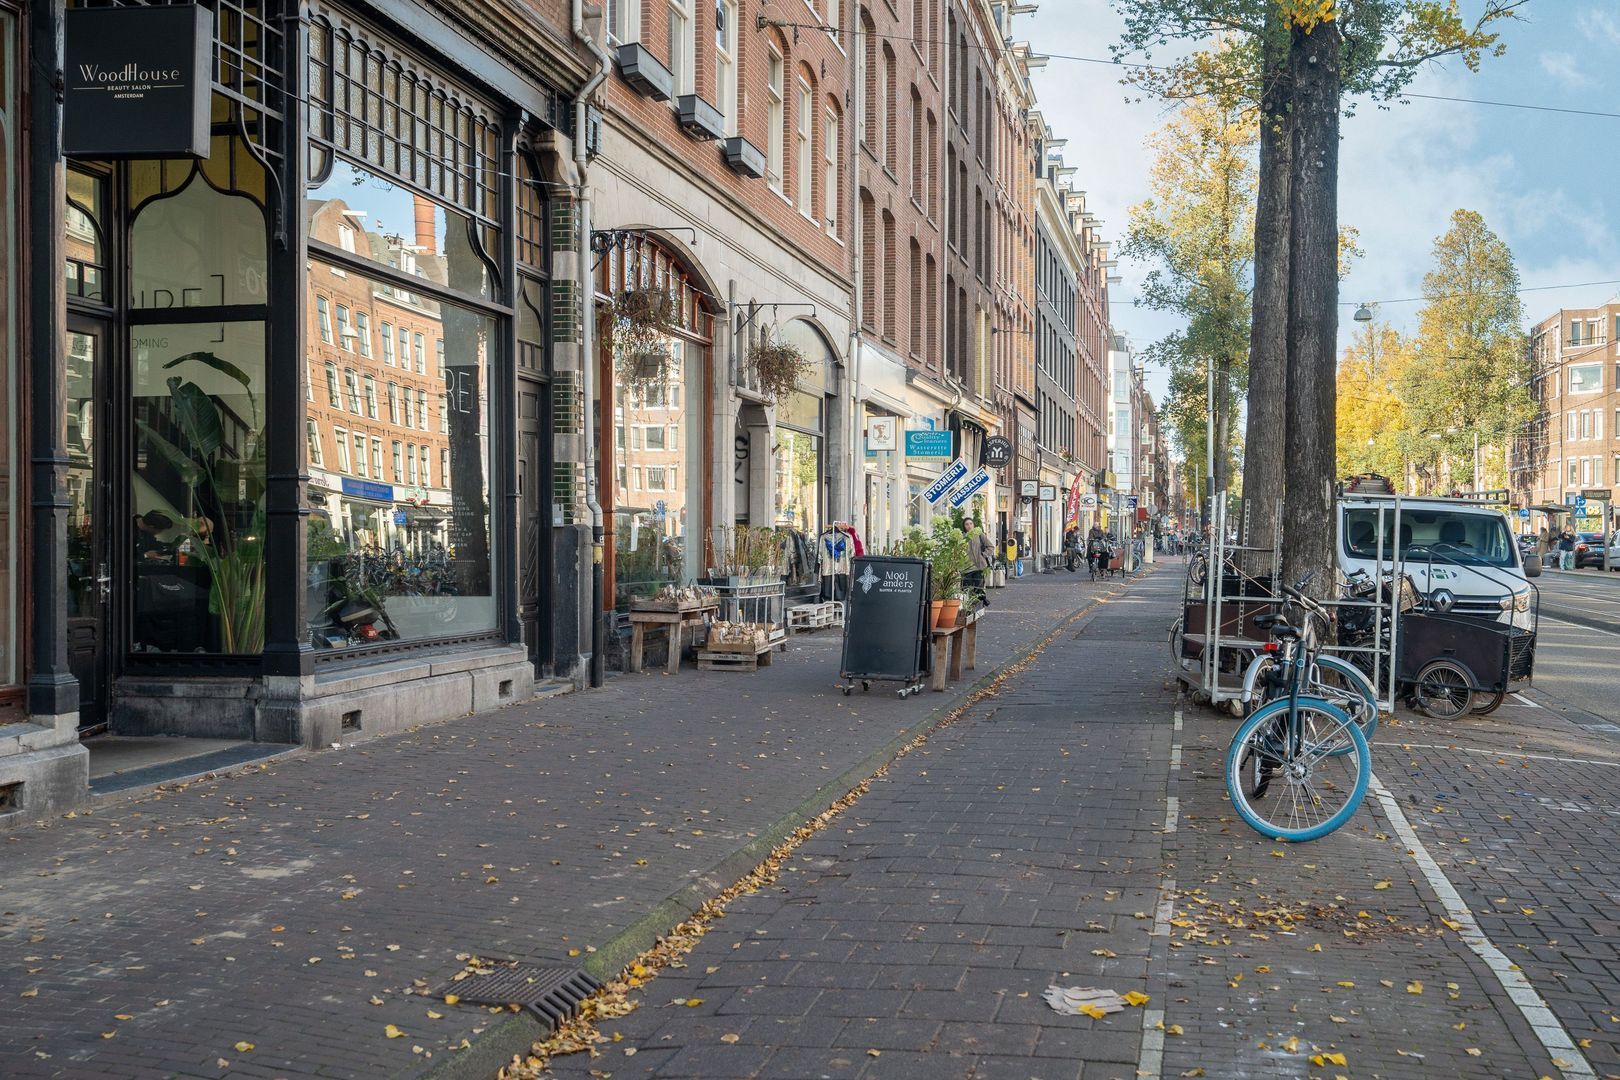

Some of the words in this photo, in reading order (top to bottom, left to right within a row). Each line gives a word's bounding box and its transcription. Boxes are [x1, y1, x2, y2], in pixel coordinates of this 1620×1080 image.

[79, 62, 180, 82] WoodHouse
[925, 463, 964, 500] STOMERIJ
[950, 471, 987, 504] WASSALON
[882, 579, 914, 588] anders
[885, 570, 908, 581] Mooi
